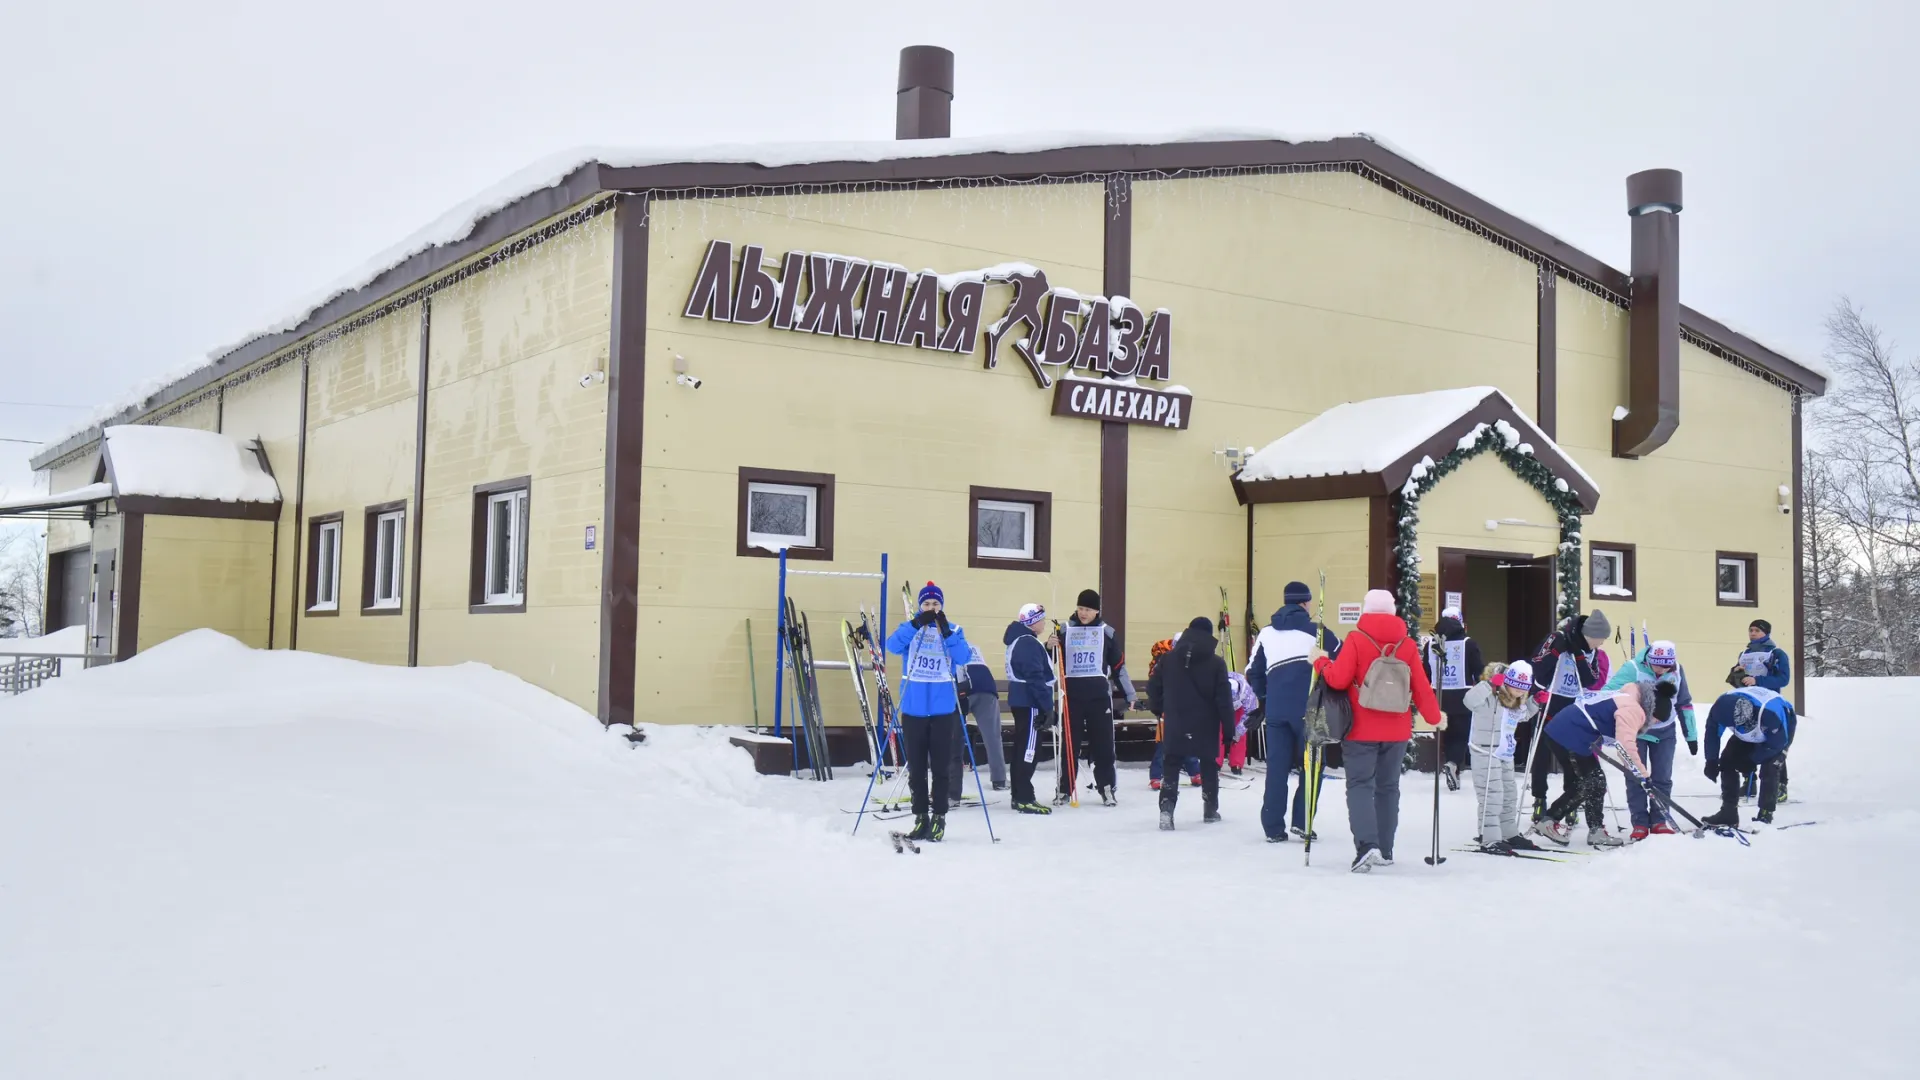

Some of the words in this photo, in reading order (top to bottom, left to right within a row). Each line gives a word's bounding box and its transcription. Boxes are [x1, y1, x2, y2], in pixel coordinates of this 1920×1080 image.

[683, 239, 986, 354] ЛЫЖНАЯ
[1043, 293, 1171, 381] БАЗА
[1070, 385, 1181, 428] САЛЕХАРД
[918, 655, 941, 671] 1931
[1073, 651, 1095, 664] 1876
[1443, 665, 1456, 677] 82
